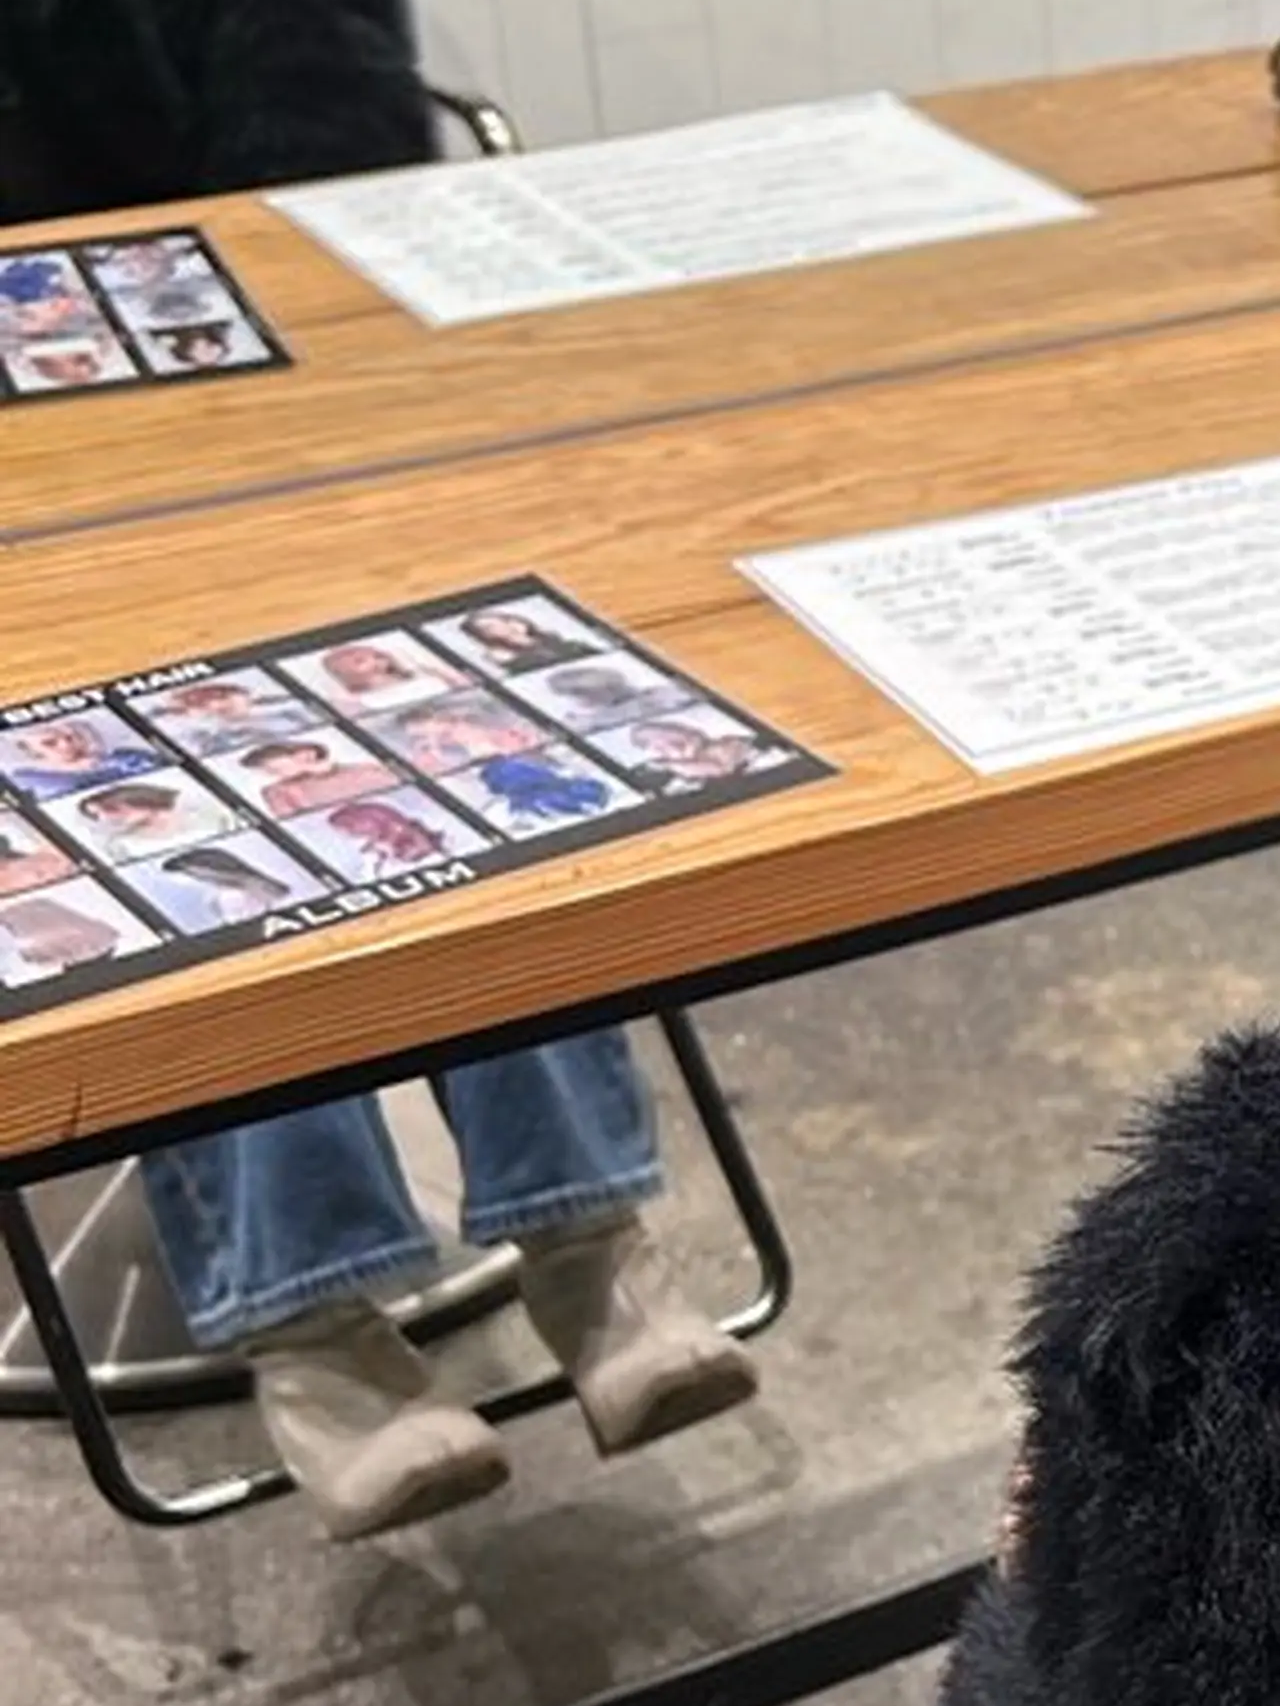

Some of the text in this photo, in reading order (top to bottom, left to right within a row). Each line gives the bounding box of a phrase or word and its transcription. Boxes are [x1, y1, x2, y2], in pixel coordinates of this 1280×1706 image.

[3, 662, 215, 724] BEST HAIR
[262, 860, 477, 939] ALBUM
